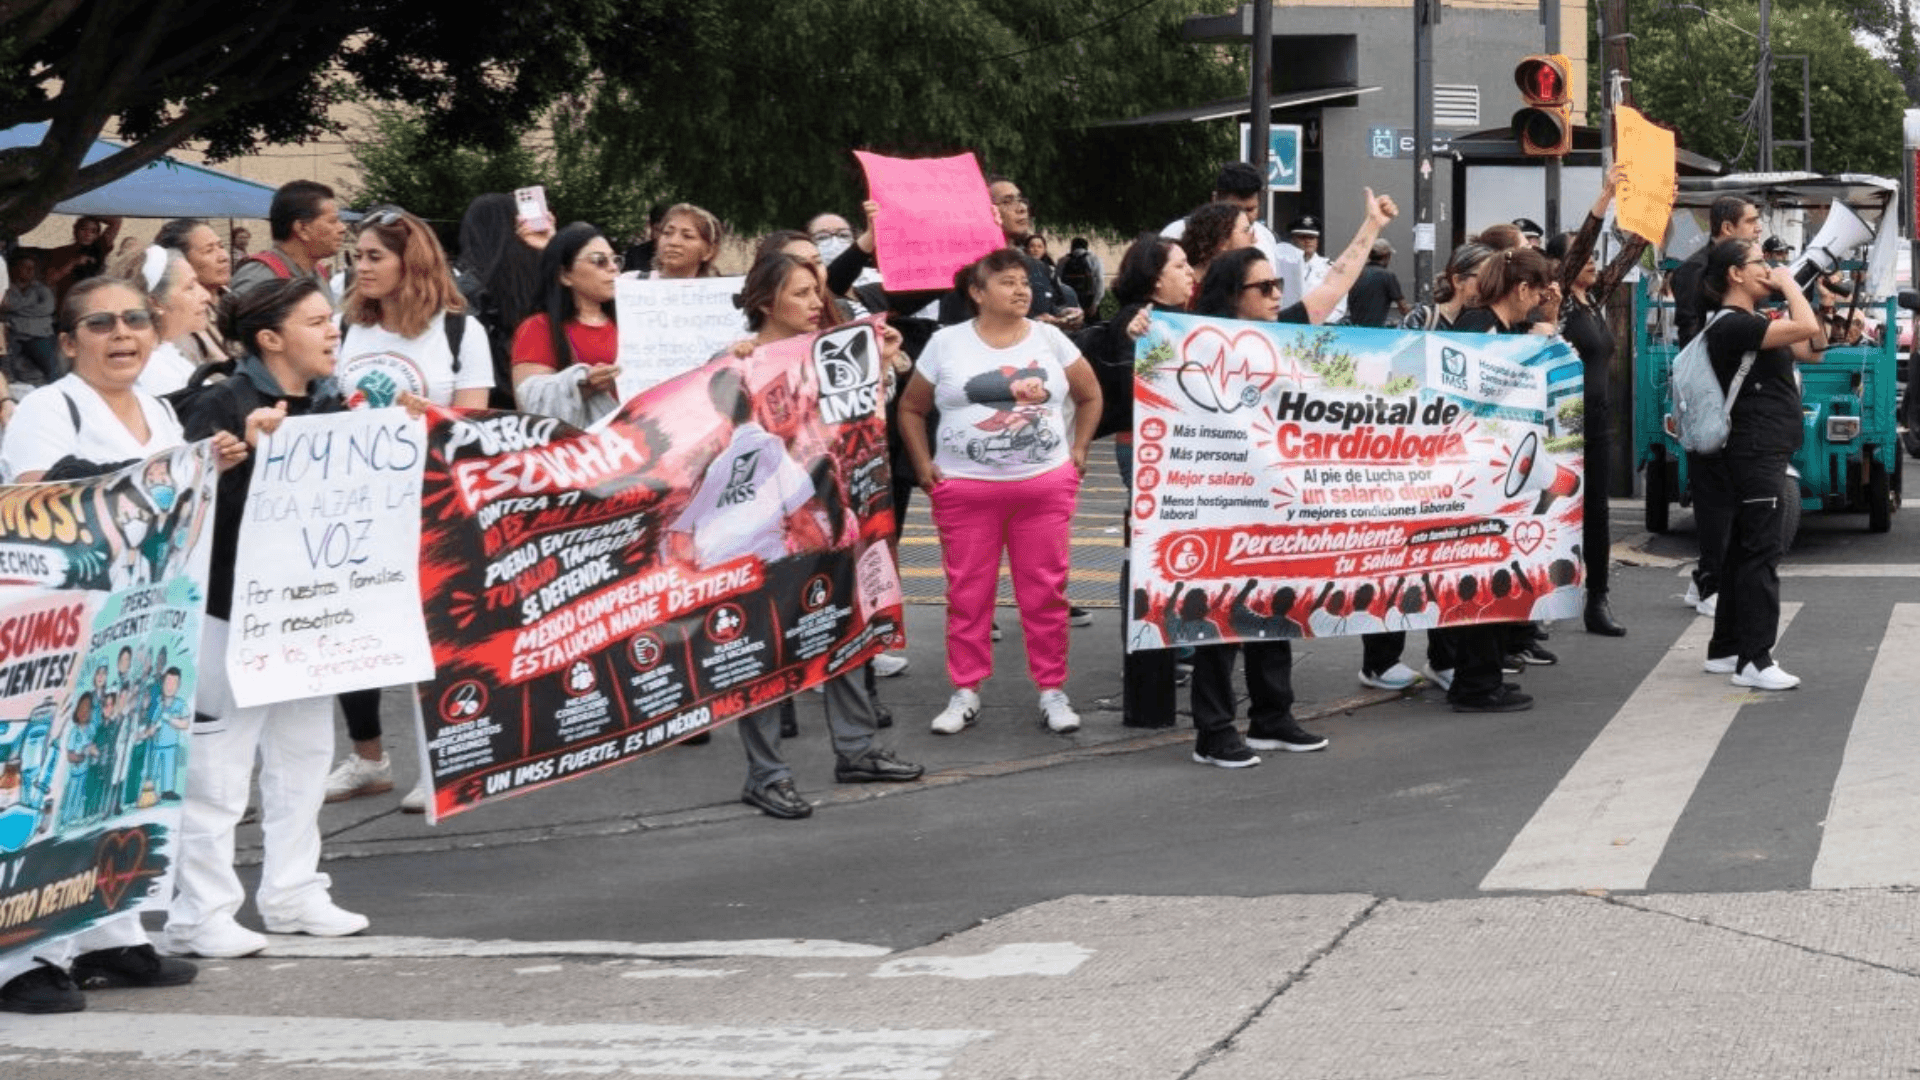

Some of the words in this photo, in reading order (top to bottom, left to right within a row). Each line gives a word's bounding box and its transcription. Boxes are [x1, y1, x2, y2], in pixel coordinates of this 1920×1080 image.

[1442, 373, 1469, 391] IMSS
[1277, 391, 1417, 430] Hospital
[1422, 397, 1460, 426] de
[1173, 425, 1197, 438] Más
[1199, 425, 1248, 440] insumos
[1277, 422, 1468, 466] Cardiología
[262, 430, 334, 483] HOY
[347, 424, 419, 476] NOS
[1169, 447, 1193, 460] Más
[1195, 450, 1249, 463] personal
[1166, 470, 1205, 488] Mejor
[1207, 472, 1255, 487] salario
[1321, 468, 1342, 485] pie
[1345, 469, 1362, 482] de
[1365, 468, 1405, 482] Lucha
[1408, 471, 1432, 485] por
[252, 490, 300, 522] TOCA
[311, 484, 371, 519] ALZAR
[478, 494, 549, 530] CONTRA
[558, 490, 581, 507] TI
[1161, 495, 1195, 507] Menos
[1196, 496, 1269, 510] hostigamiento
[1286, 508, 1296, 521] y
[1300, 507, 1348, 522] mejores
[1350, 503, 1417, 518] condiciones
[1420, 500, 1466, 515] laborales
[1303, 488, 1325, 504] un
[1330, 485, 1396, 505] salario
[1398, 484, 1454, 505] digno
[1159, 508, 1198, 520] laboral
[301, 519, 374, 570] VOZ
[485, 542, 539, 588] PUEBLO
[540, 512, 646, 557] ENTIENDE
[1224, 526, 1408, 562] Derechohabiente,
[1334, 555, 1355, 574] tu
[1362, 551, 1405, 571] salud
[1409, 548, 1428, 564] se
[1431, 535, 1503, 563] defiende.
[484, 584, 516, 610] TU
[539, 554, 620, 612] DEFIENDE.
[243, 613, 271, 640] Por
[510, 646, 565, 680] ESTA
[562, 621, 608, 661] LUCHA
[609, 597, 660, 635] NADIE
[667, 562, 757, 613] DETIENE.
[486, 772, 511, 794] UN
[514, 759, 555, 784] IMSS
[558, 741, 620, 774] FUERTE,
[624, 732, 646, 753] ES
[646, 726, 666, 745] UN
[666, 707, 712, 739] MÉXICO
[9, 855, 26, 888] Y
